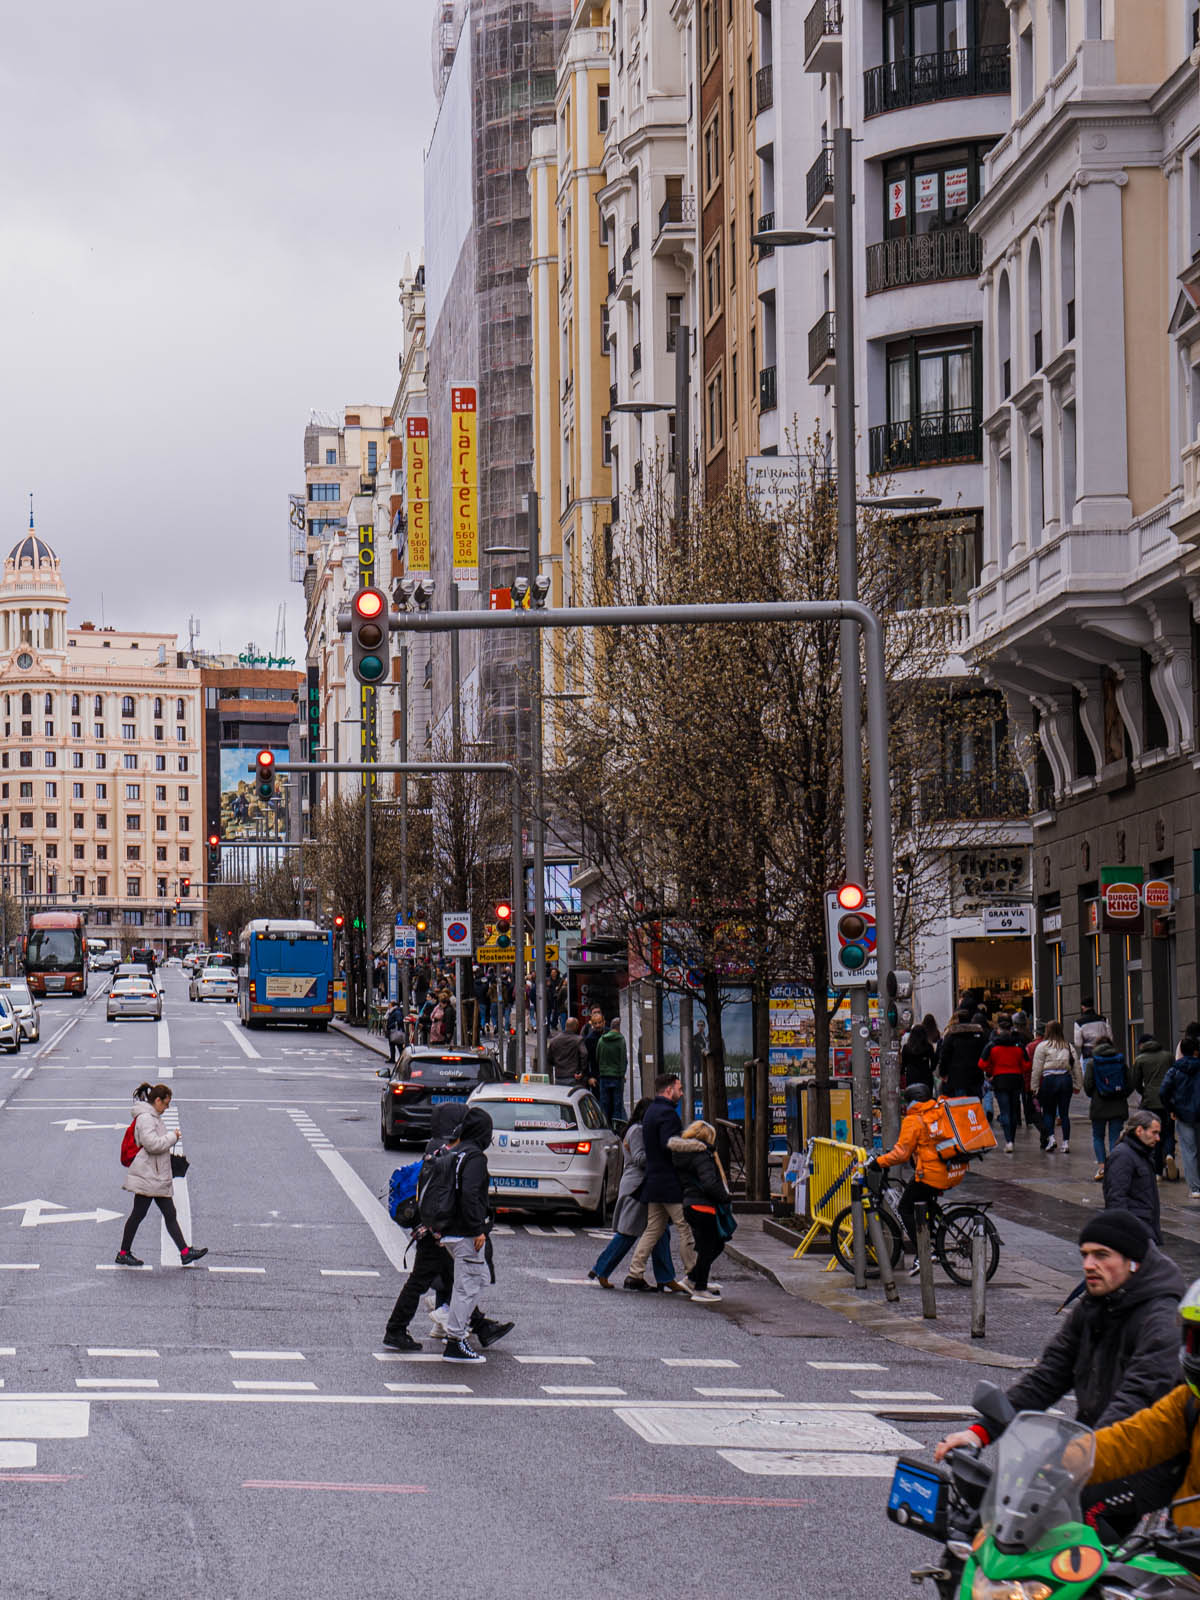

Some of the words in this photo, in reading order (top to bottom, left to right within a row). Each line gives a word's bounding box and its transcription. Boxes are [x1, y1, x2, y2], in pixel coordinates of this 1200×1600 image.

[460, 522, 471, 530] 91
[455, 531, 475, 539] 560
[459, 539, 472, 547] 52
[459, 548, 472, 557] 06
[1146, 894, 1169, 902] KING
[1107, 900, 1138, 911] KING
[1001, 919, 1013, 927] 69
[847, 969, 878, 977] VEHICU
